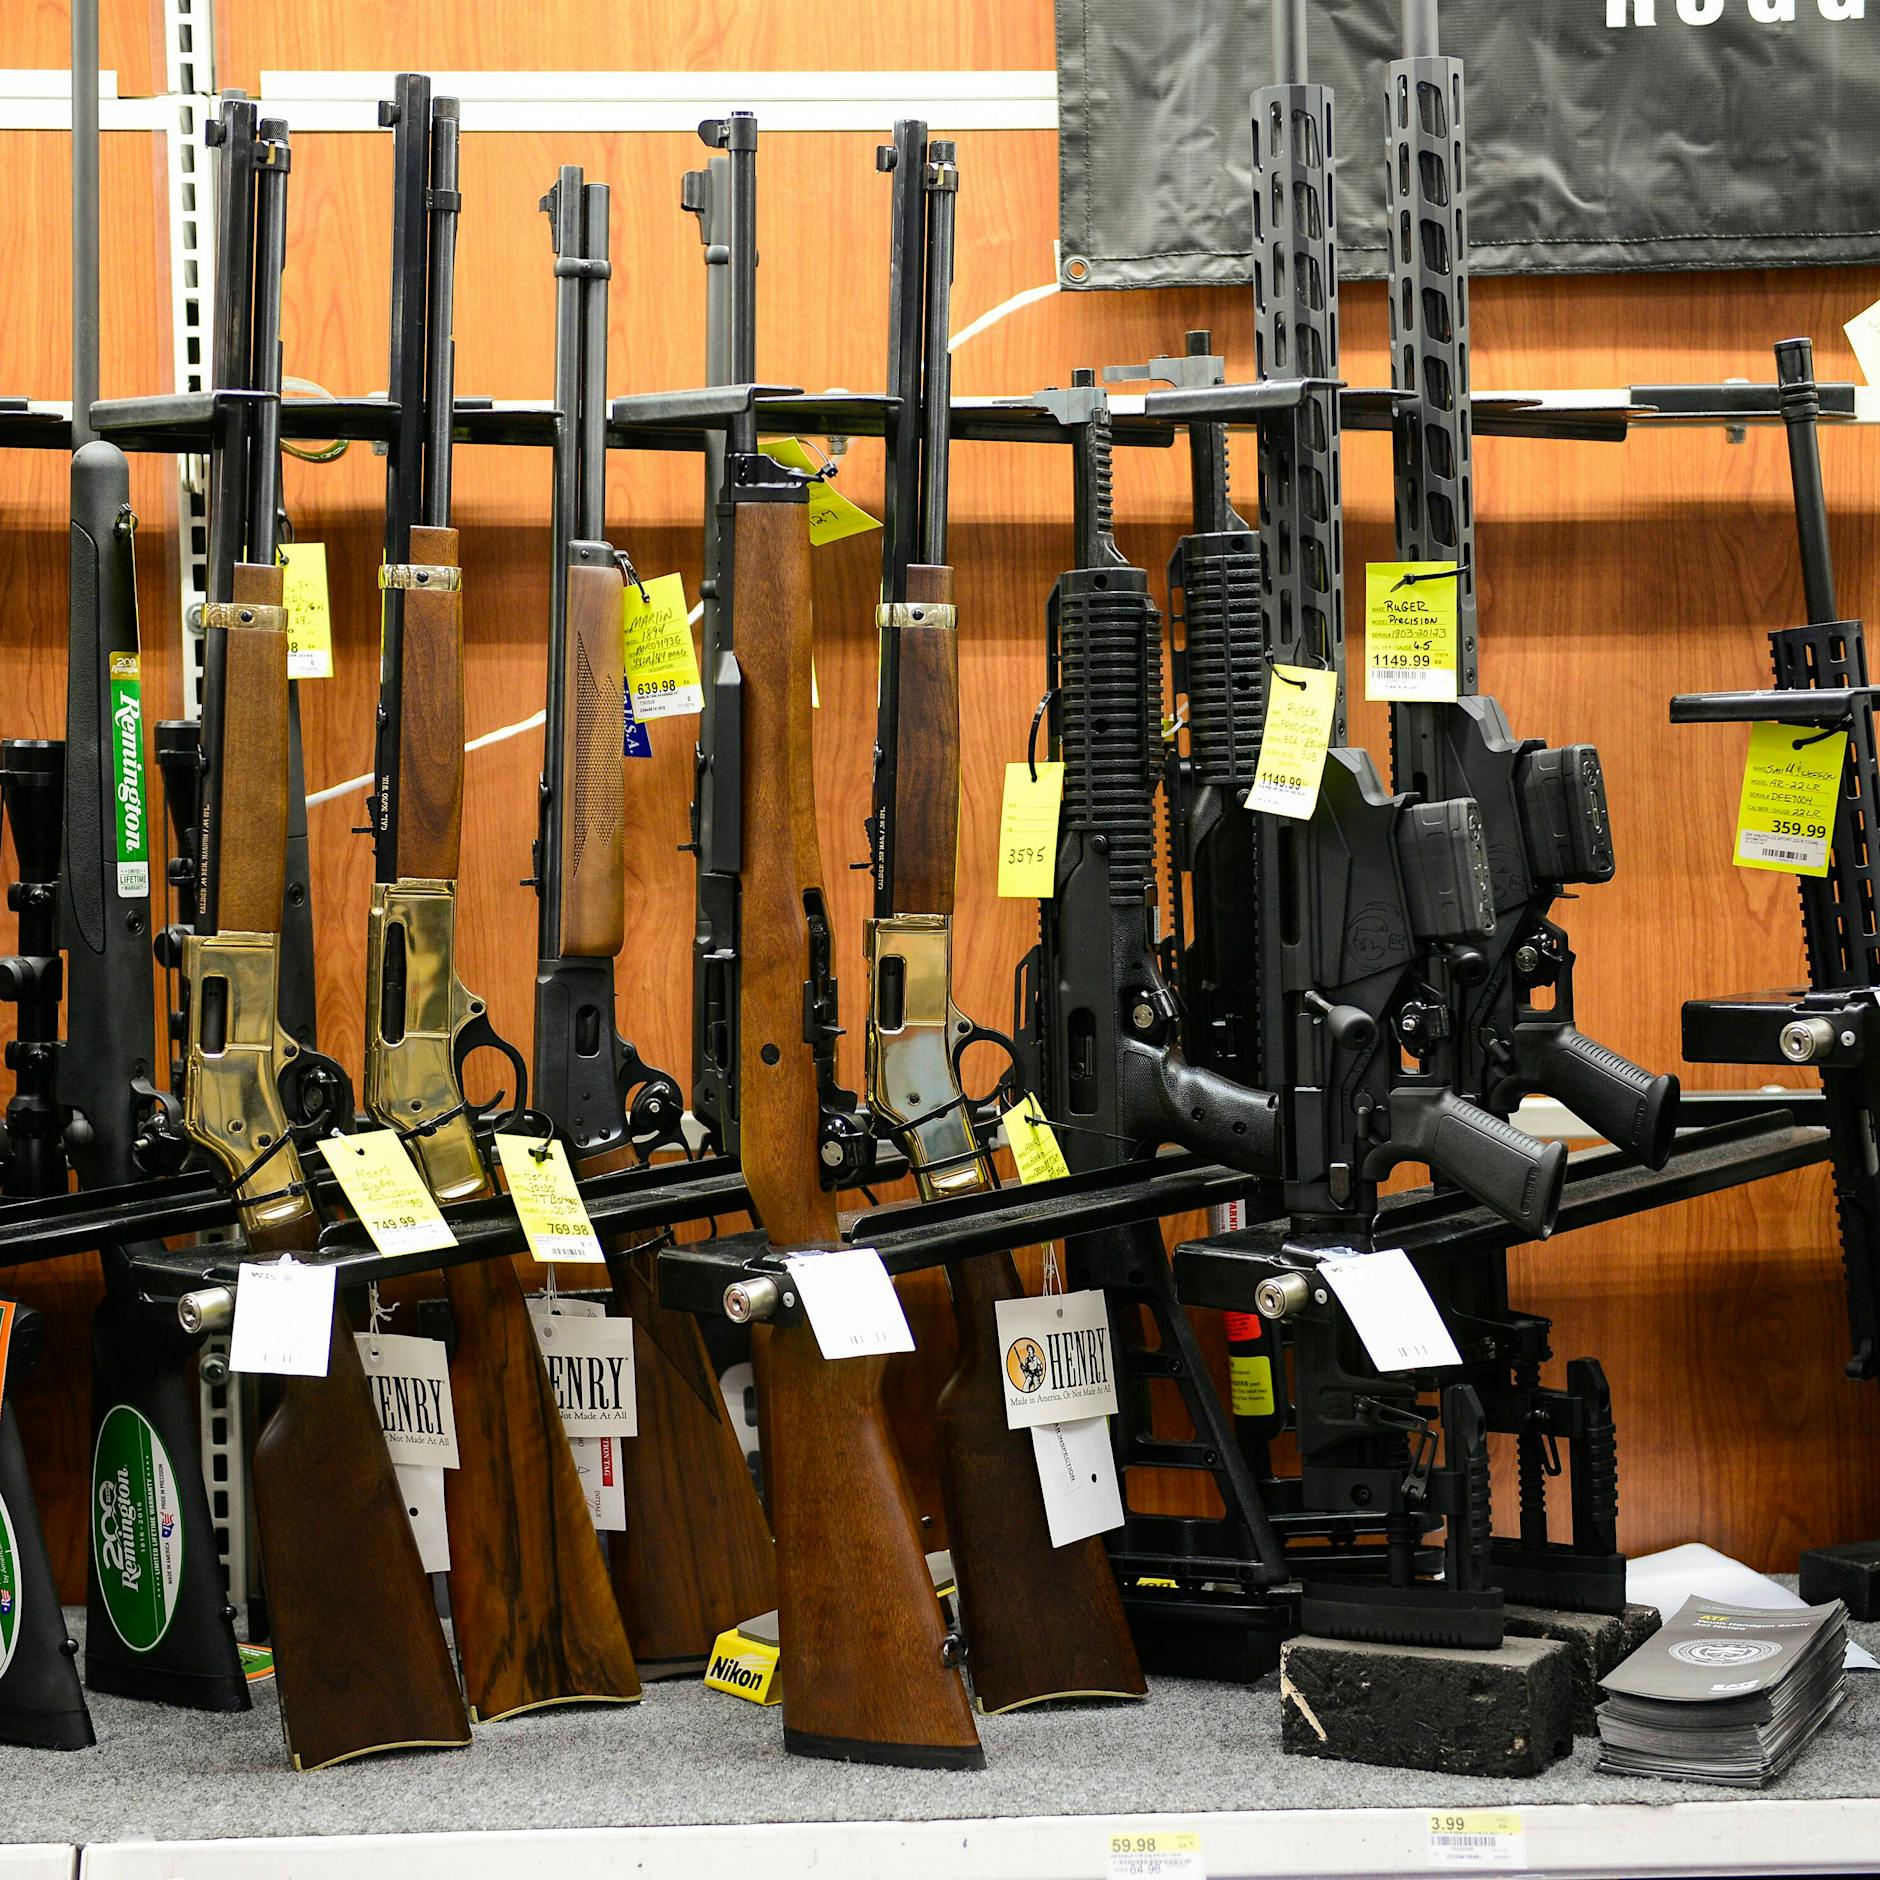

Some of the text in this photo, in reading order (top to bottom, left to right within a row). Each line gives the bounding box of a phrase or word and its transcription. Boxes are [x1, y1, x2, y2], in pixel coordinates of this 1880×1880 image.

[641, 622, 666, 643] 1894
[1373, 653, 1430, 667] 1149.99
[637, 679, 676, 695] 639.98
[115, 690, 143, 852] Remington
[1261, 771, 1302, 791] 1149.99
[1771, 819, 1827, 839] 359.99
[1008, 846, 1046, 864] 3595
[120, 875, 147, 884] LIFETIME
[372, 1216, 416, 1231] 749.99
[547, 1223, 590, 1236] 769.98
[1046, 1327, 1107, 1390] HENRY
[547, 1355, 625, 1410] ENRY
[1010, 1398, 1028, 1407] Made
[1029, 1396, 1036, 1404] in
[1063, 1392, 1072, 1400] Or
[1072, 1390, 1082, 1399] Not
[1083, 1388, 1096, 1396] Made
[1096, 1386, 1104, 1394] At
[1103, 1384, 1111, 1393] All
[574, 1411, 597, 1420] Made
[599, 1411, 612, 1420] At
[613, 1411, 627, 1420] All
[389, 1434, 450, 1447] Not Made At All
[603, 1459, 612, 1477] TAG
[594, 1490, 602, 1518] INITIALS
[118, 1467, 142, 1592] Remington
[146, 1478, 160, 1576] LIMITED LIFETIME WARRANTY
[164, 1542, 172, 1563] AMERICA
[3, 1574, 10, 1584] by
[710, 1655, 763, 1691] Nikon
[1431, 1817, 1464, 1831] 3.99
[1112, 1838, 1156, 1852] 59.98
